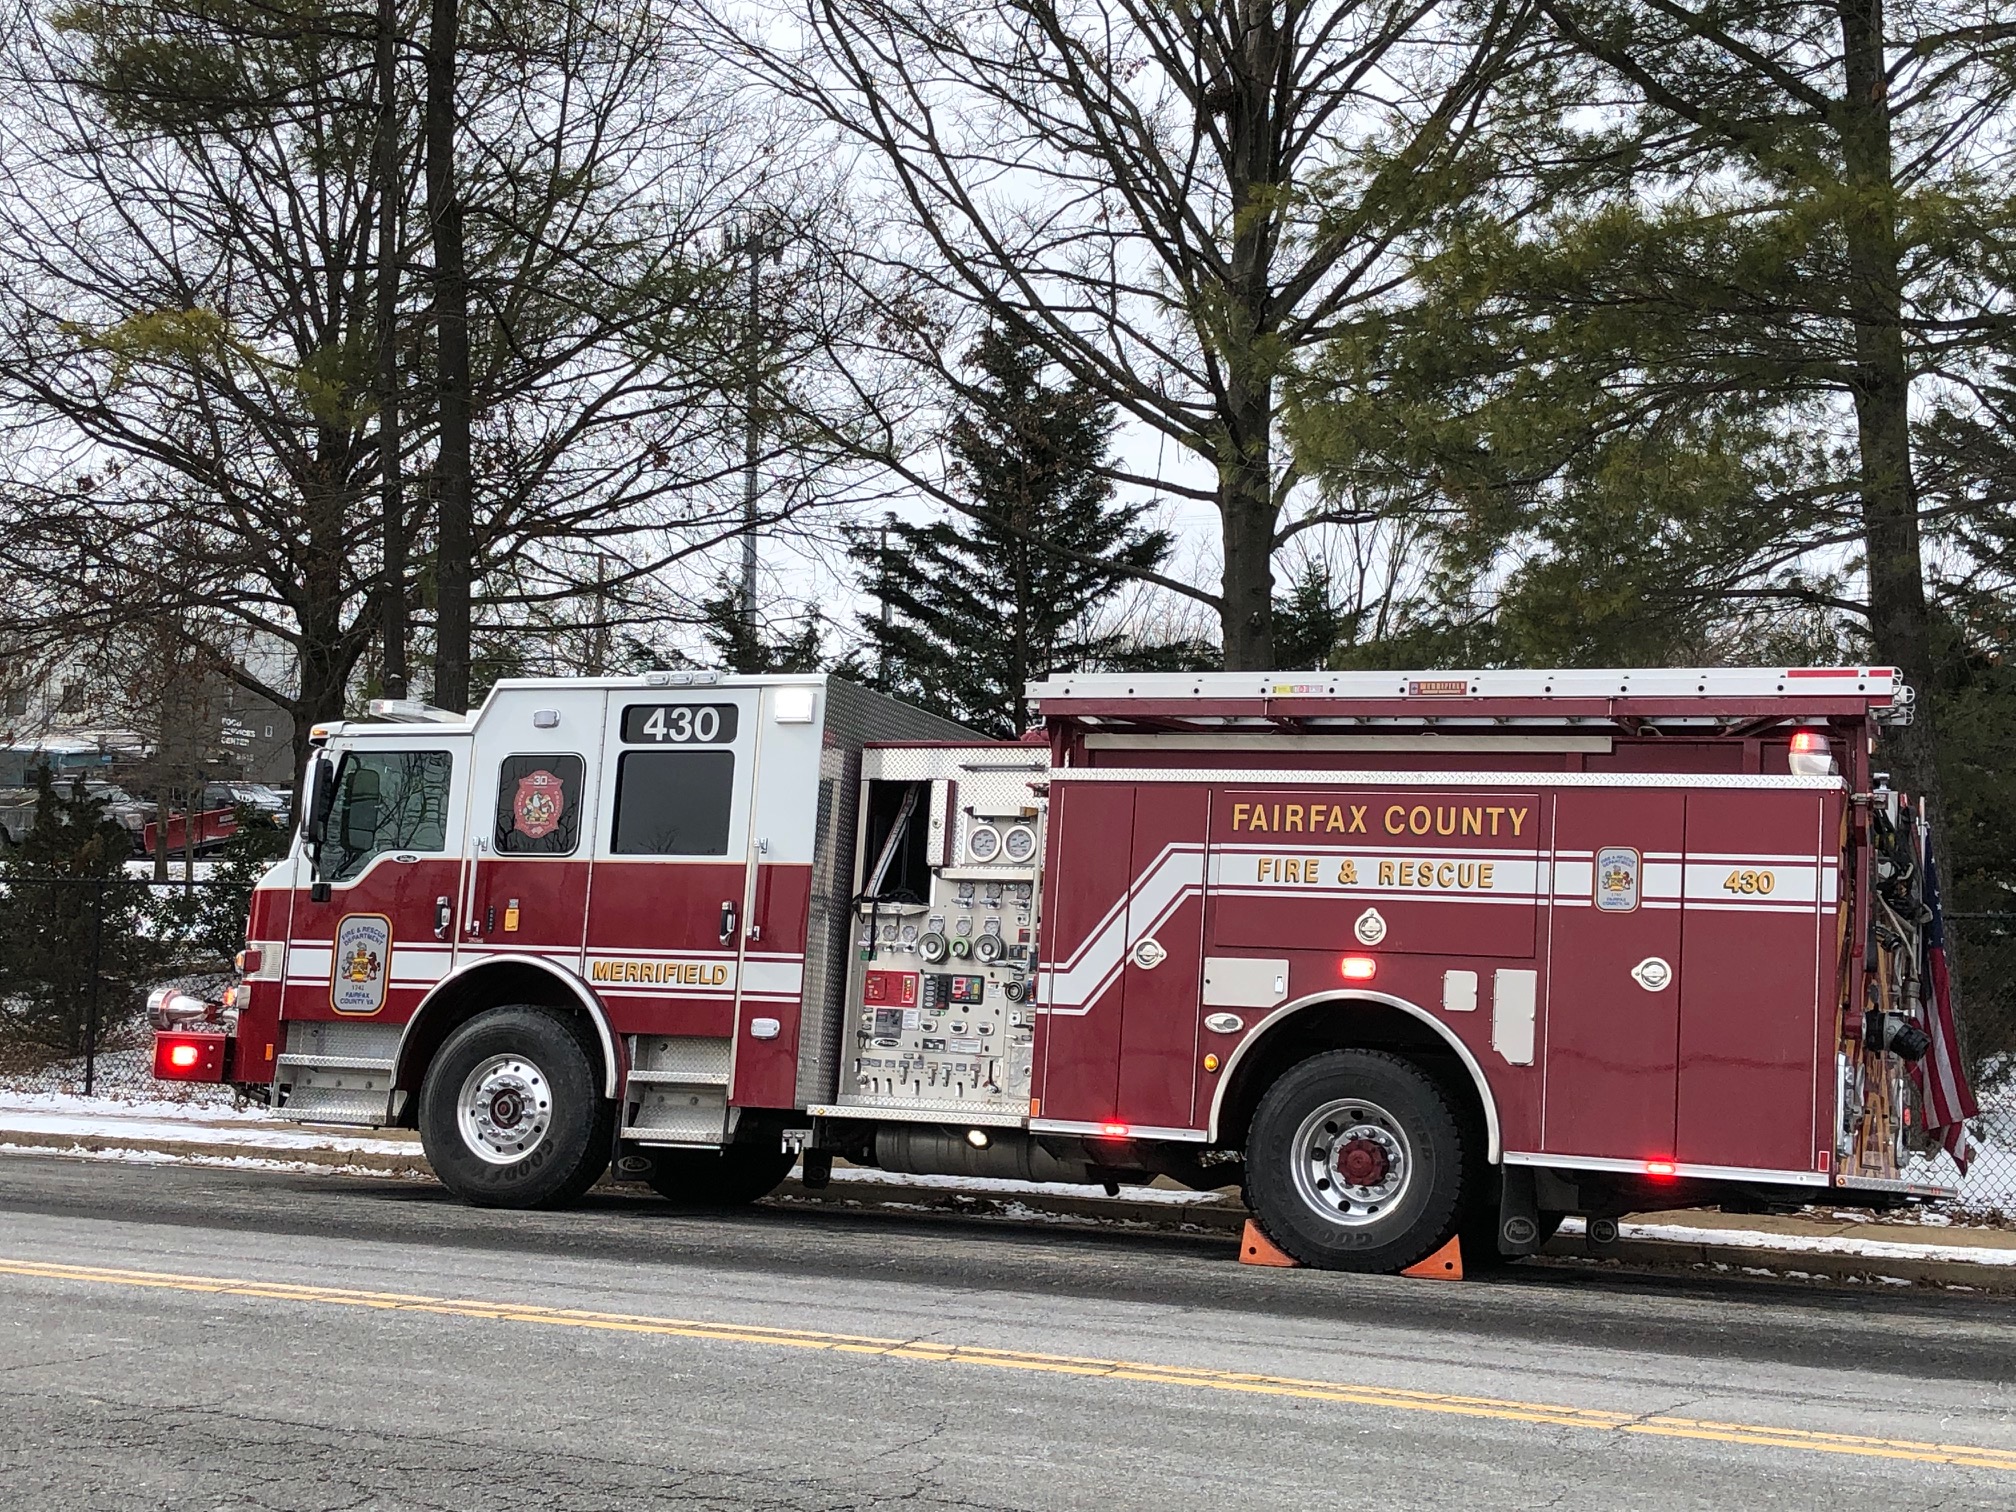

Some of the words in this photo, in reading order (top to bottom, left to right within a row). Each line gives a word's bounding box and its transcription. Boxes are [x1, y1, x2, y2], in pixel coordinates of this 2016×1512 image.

[643, 706, 720, 742] 430
[533, 775, 548, 786] 30
[1232, 803, 1368, 834] FAIRFAX
[1384, 805, 1528, 837] COUNTY
[1258, 858, 1319, 884] FIRE
[1338, 859, 1358, 885] &
[1379, 861, 1494, 889] RESCUE
[1723, 870, 1775, 895] 430
[341, 928, 355, 940] FIRE
[362, 926, 386, 939] RESCUE
[343, 932, 384, 947] DEPARTMENT
[592, 961, 728, 986] MERRIFIELD
